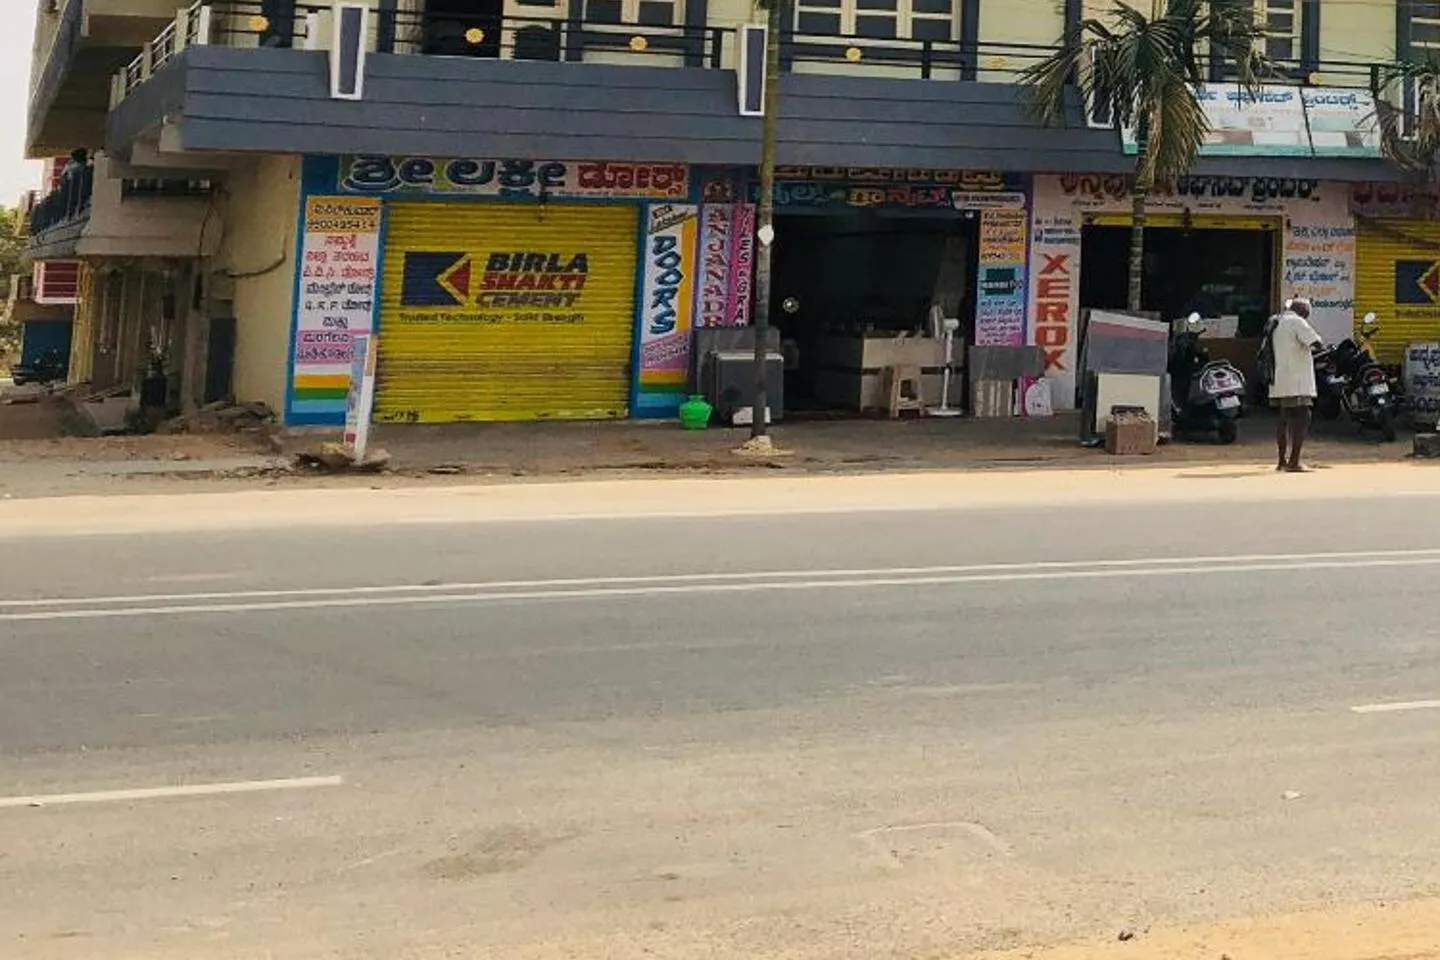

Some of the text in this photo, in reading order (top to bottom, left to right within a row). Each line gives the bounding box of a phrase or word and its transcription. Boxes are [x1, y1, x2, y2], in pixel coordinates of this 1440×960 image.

[486, 252, 589, 273] BIRLA
[480, 272, 588, 291] SHAKTI
[649, 235, 685, 335] DOORS
[475, 292, 582, 308] CEMENT
[440, 312, 504, 324] Technology
[1035, 252, 1071, 371] XEROX
